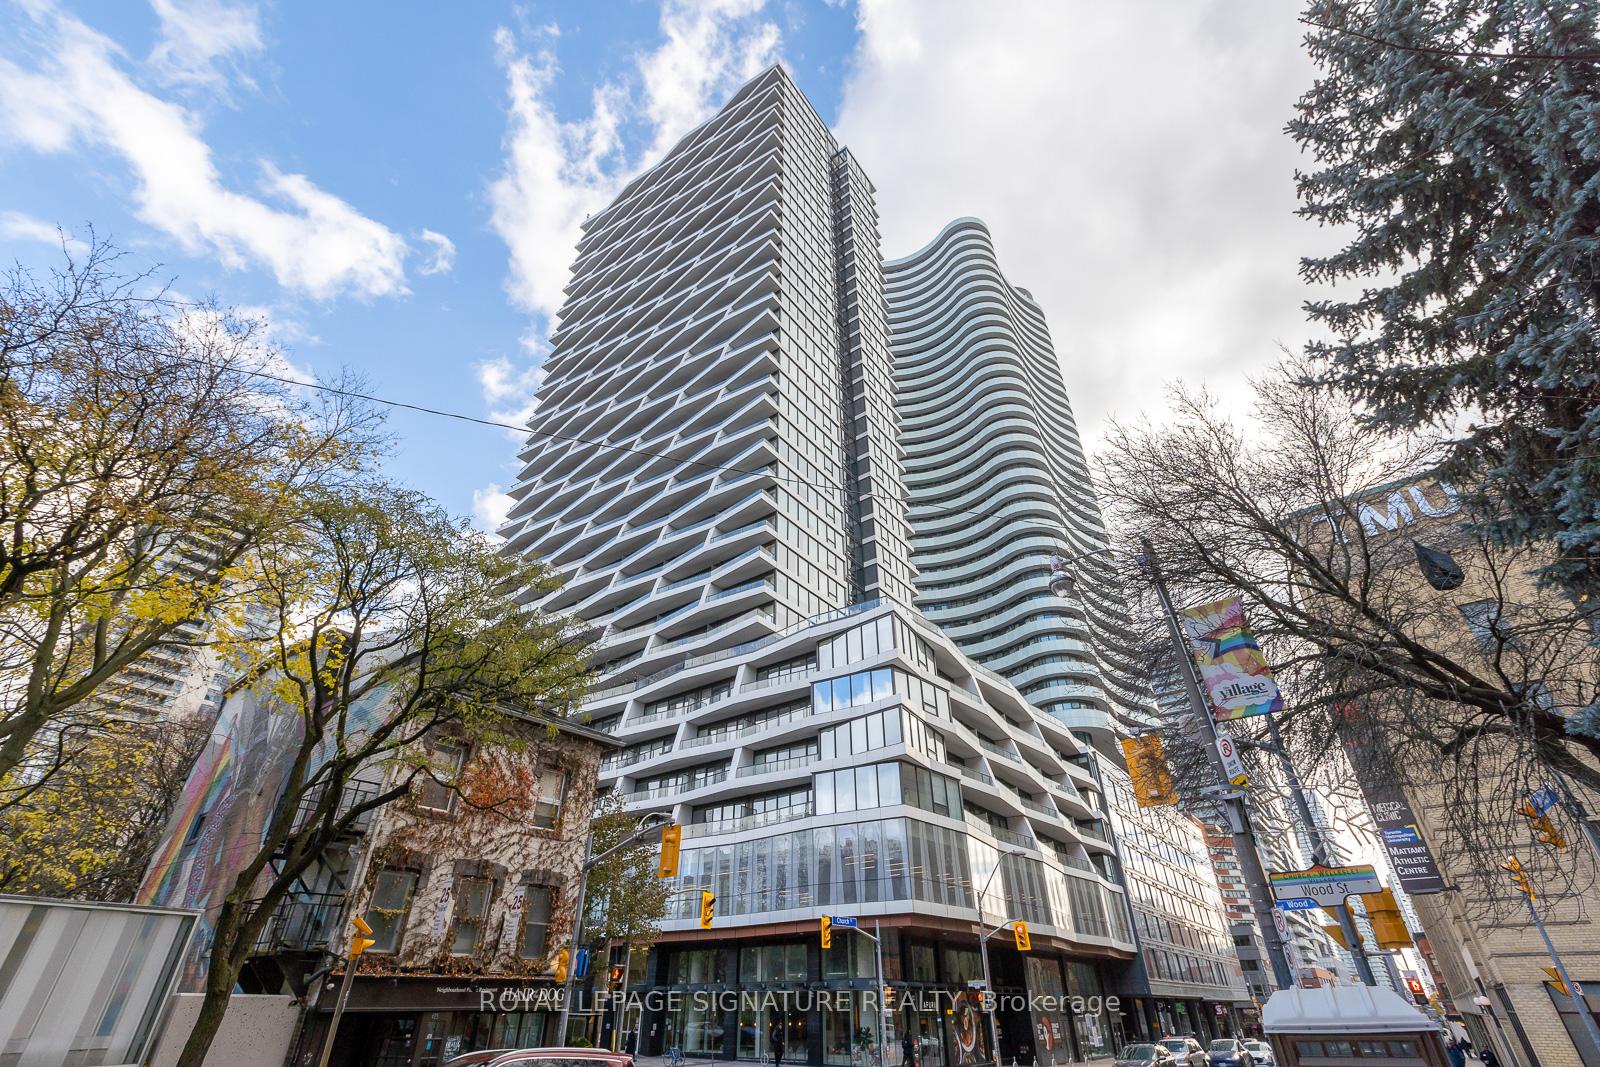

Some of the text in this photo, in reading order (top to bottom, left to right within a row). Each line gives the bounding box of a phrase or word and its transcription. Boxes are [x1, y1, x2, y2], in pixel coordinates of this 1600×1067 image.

[1389, 846, 1427, 856] MATTAMY
[1394, 856, 1430, 866] ATHLETIC
[1397, 866, 1429, 876] CENTRE
[440, 887, 451, 904] 25
[1301, 882, 1353, 897] Wood St.
[512, 895, 523, 911] 25
[1287, 900, 1308, 909] Wood
[502, 987, 534, 1002] HAIR
[538, 987, 565, 1002] DOG
